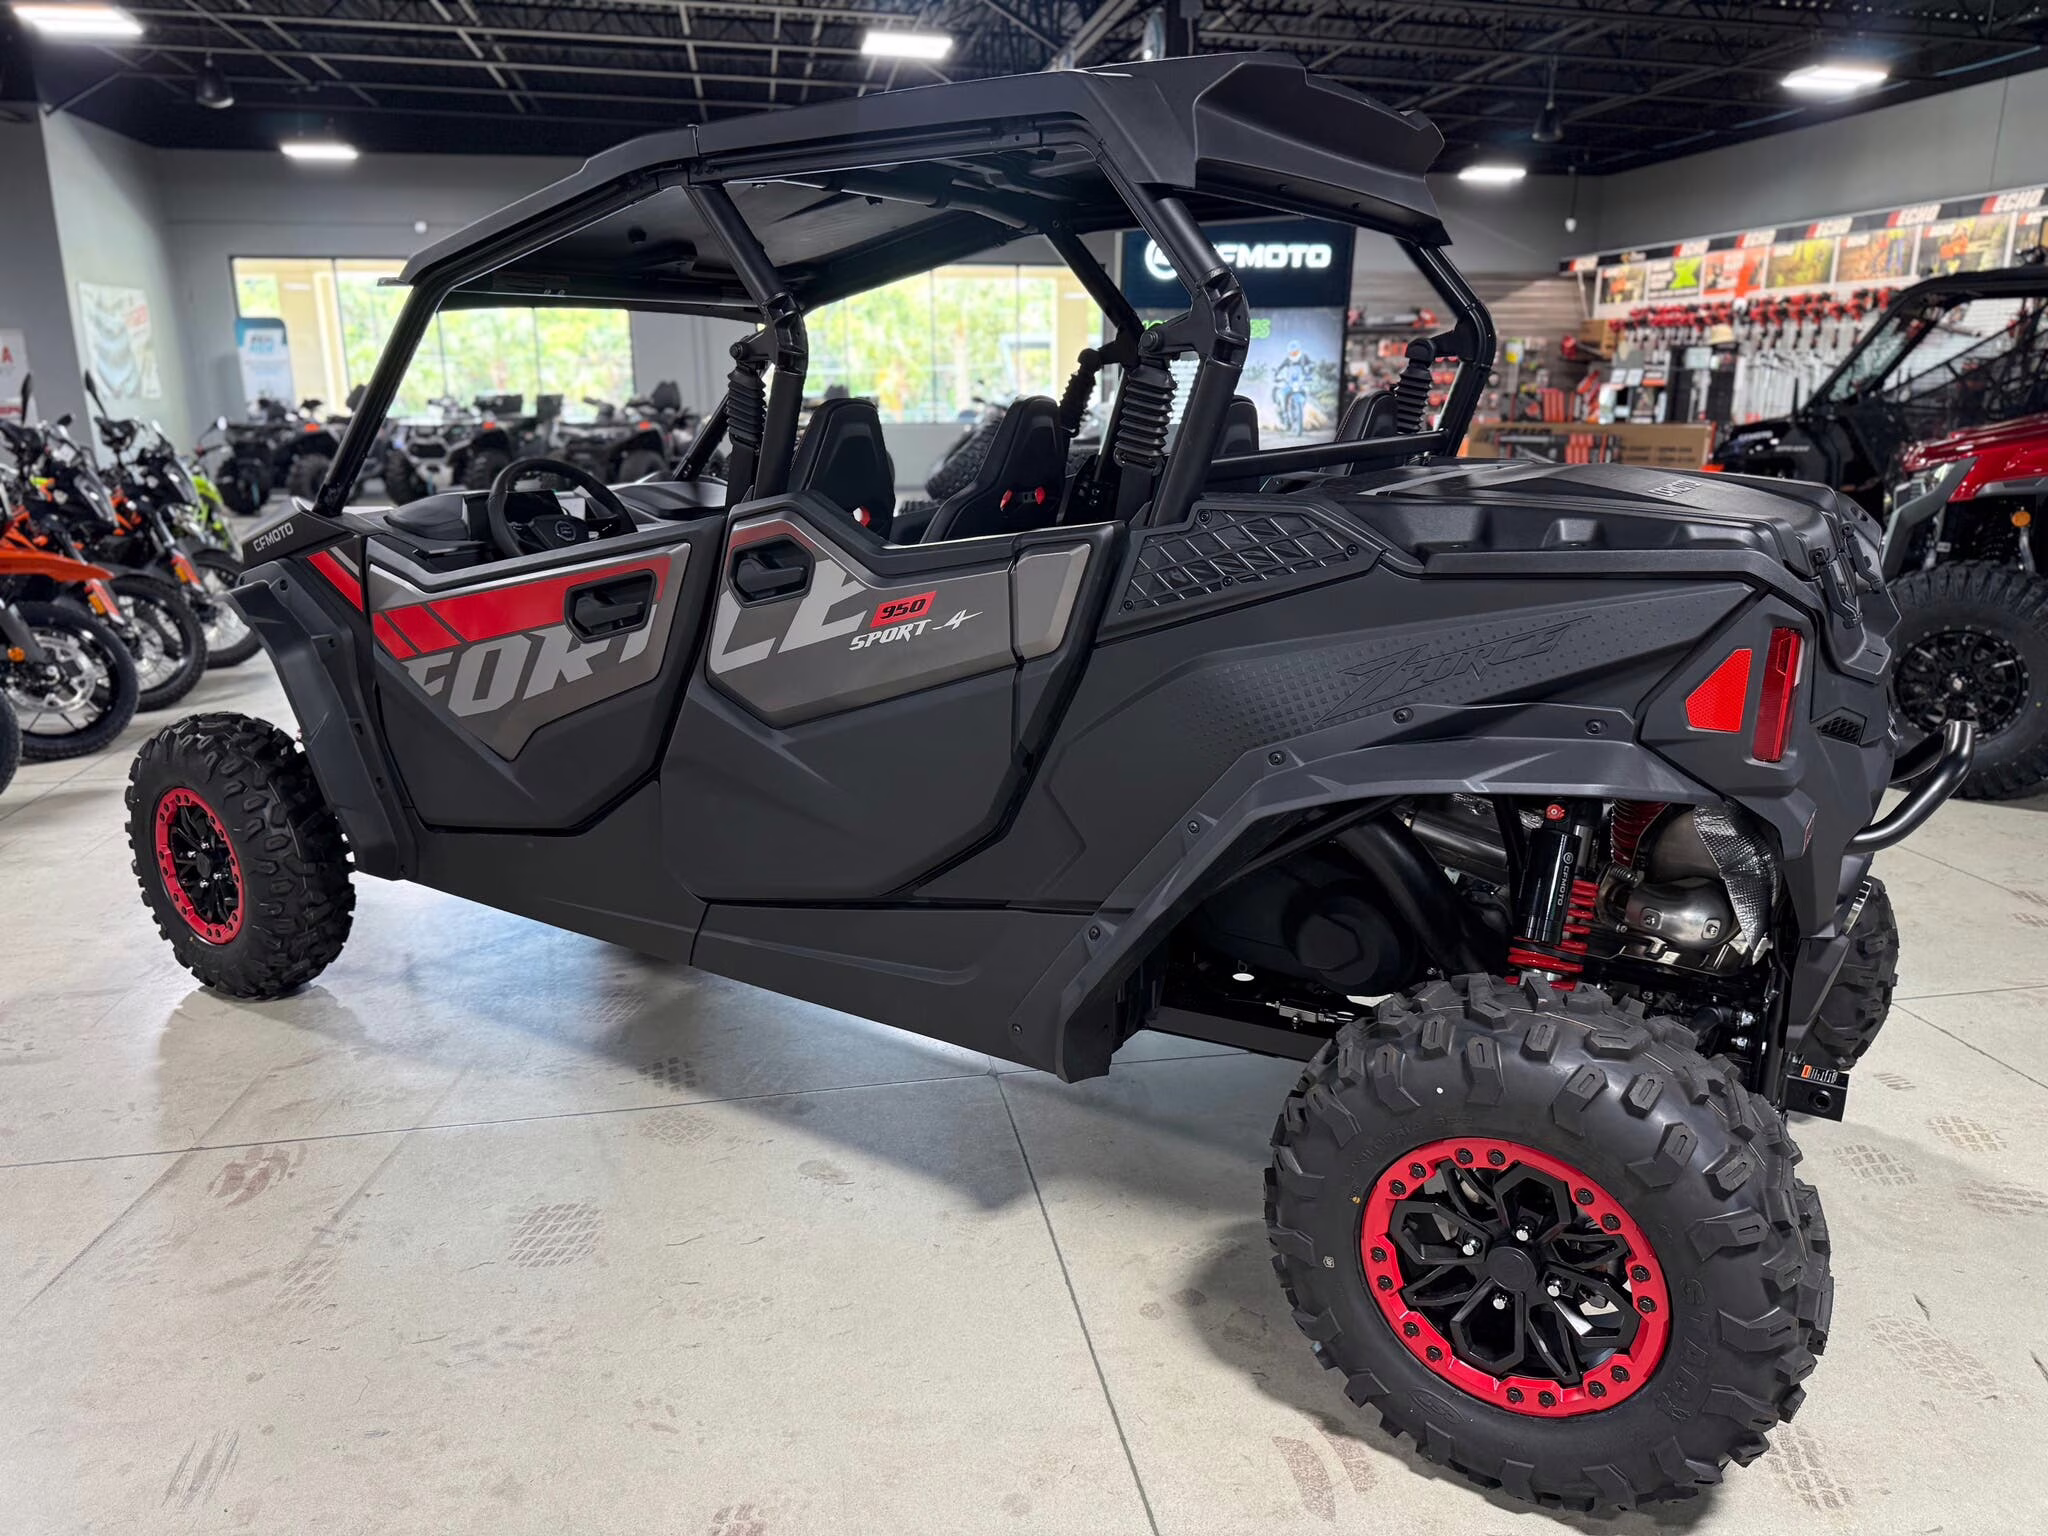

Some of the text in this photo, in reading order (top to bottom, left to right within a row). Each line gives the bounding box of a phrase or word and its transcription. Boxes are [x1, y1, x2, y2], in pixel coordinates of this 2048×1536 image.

[1213, 243, 1333, 269] FMOTO
[252, 522, 295, 552] CFMOTO
[880, 598, 927, 620] 950
[848, 619, 932, 651] SPORT
[1557, 865, 1570, 906] CFMOTO
